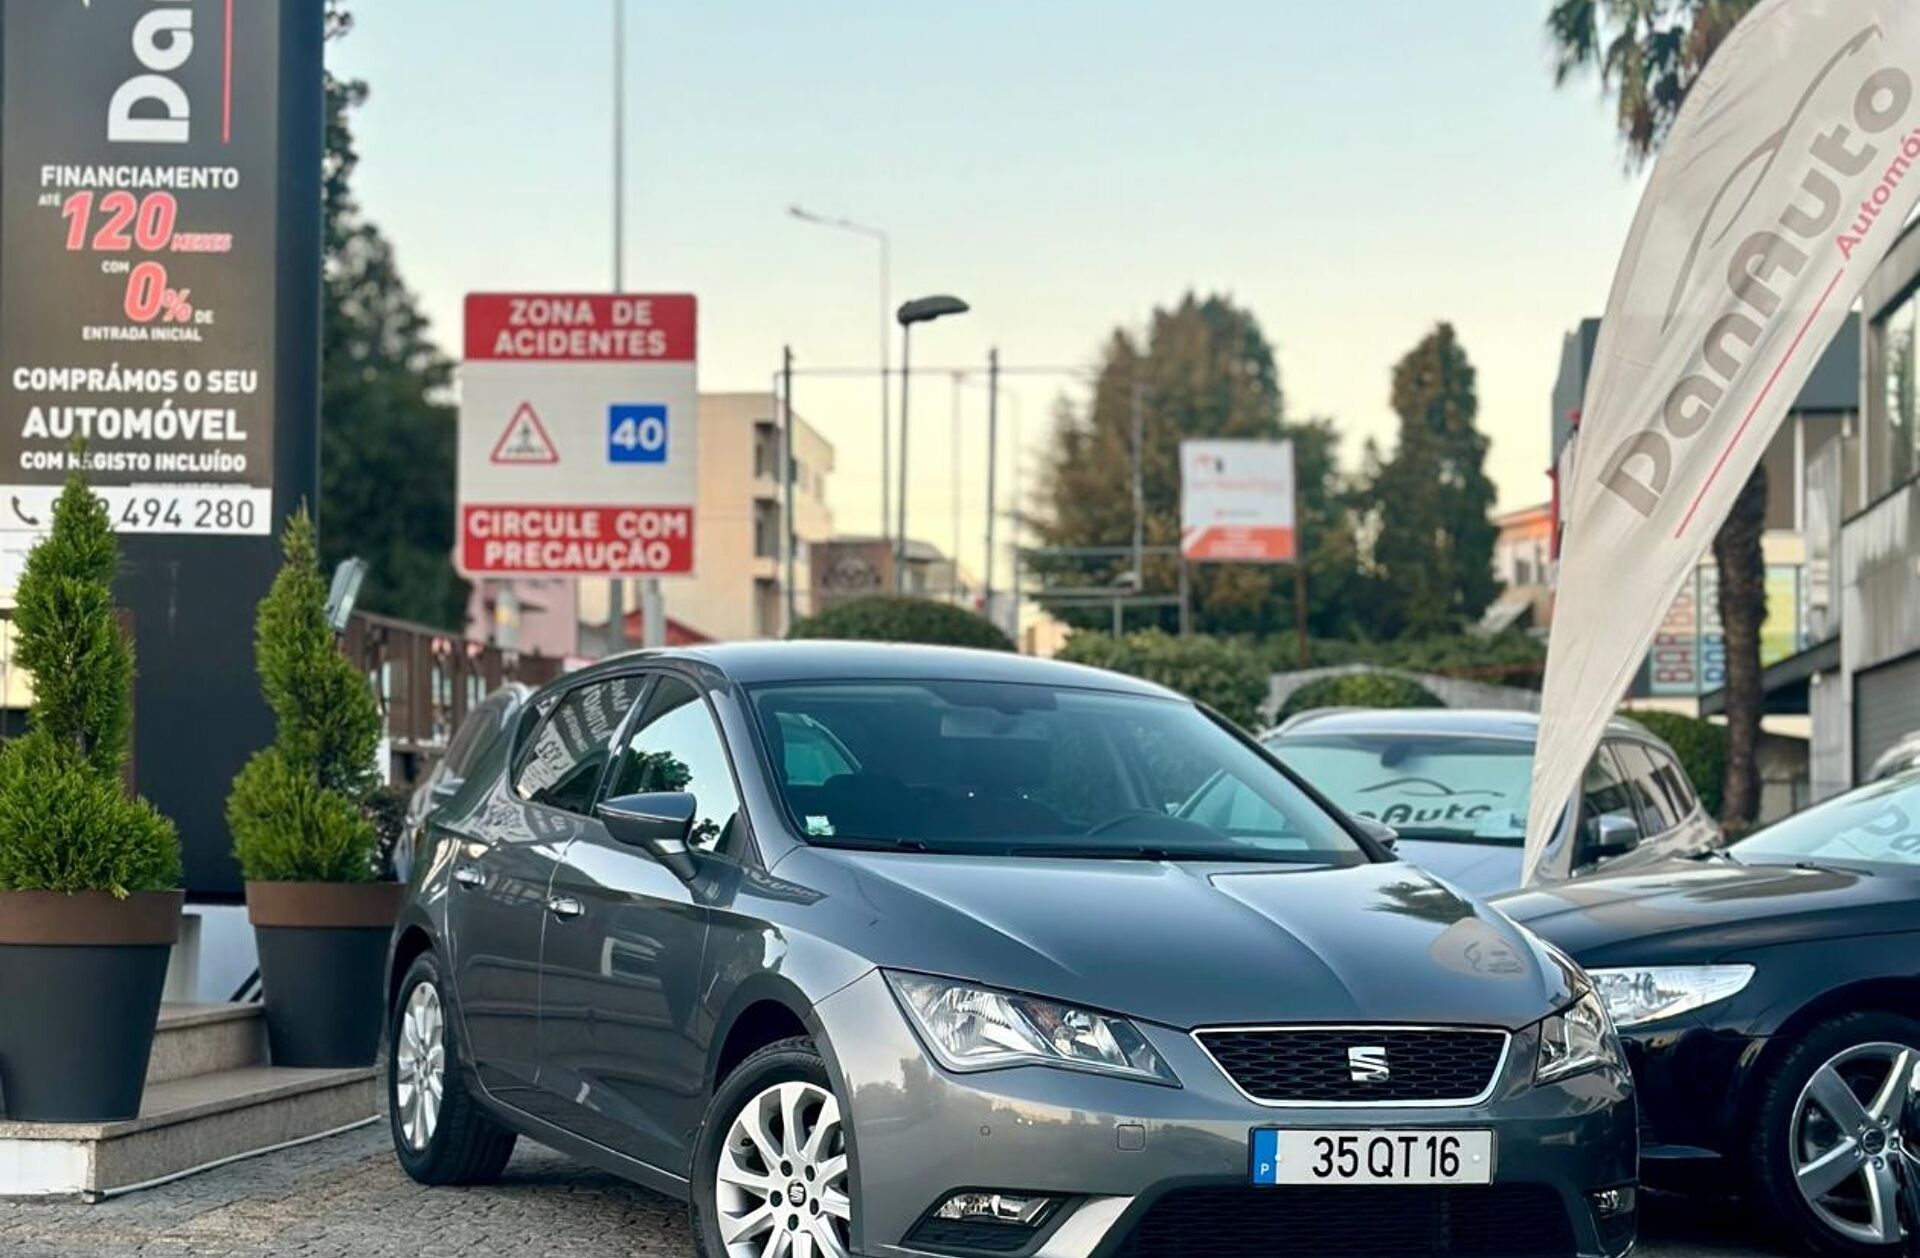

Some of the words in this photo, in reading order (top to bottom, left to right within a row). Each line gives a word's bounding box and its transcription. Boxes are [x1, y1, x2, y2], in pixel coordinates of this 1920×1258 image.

[107, 0, 194, 143] Da
[40, 165, 239, 189] FINANCIAMENTO
[1835, 127, 1920, 260] Automó
[38, 193, 61, 207] ATÉ
[61, 190, 177, 251] 120
[101, 260, 130, 273] COM
[124, 261, 192, 323] 0%
[195, 310, 214, 324] DE
[1598, 66, 1913, 519] DanAuto
[509, 300, 594, 326] ZONA
[612, 301, 652, 326] DE
[82, 326, 148, 340] ENTRADA
[151, 327, 202, 342] INICIAL
[494, 330, 667, 355] ACIDENTES
[13, 362, 178, 392] COMPRÁMOS
[184, 370, 201, 392] O
[207, 370, 258, 393] SEU
[21, 398, 248, 441] AUTOMÓVEL
[611, 418, 664, 450] 40
[20, 451, 63, 470] COM
[155, 448, 247, 472] INCLUÍDO
[121, 498, 182, 528] 494
[194, 499, 254, 529] 280
[468, 510, 600, 539] CIRCULE
[615, 511, 688, 539] COM
[484, 538, 671, 571] PRECAUÇÃO
[1260, 1163, 1269, 1176] P
